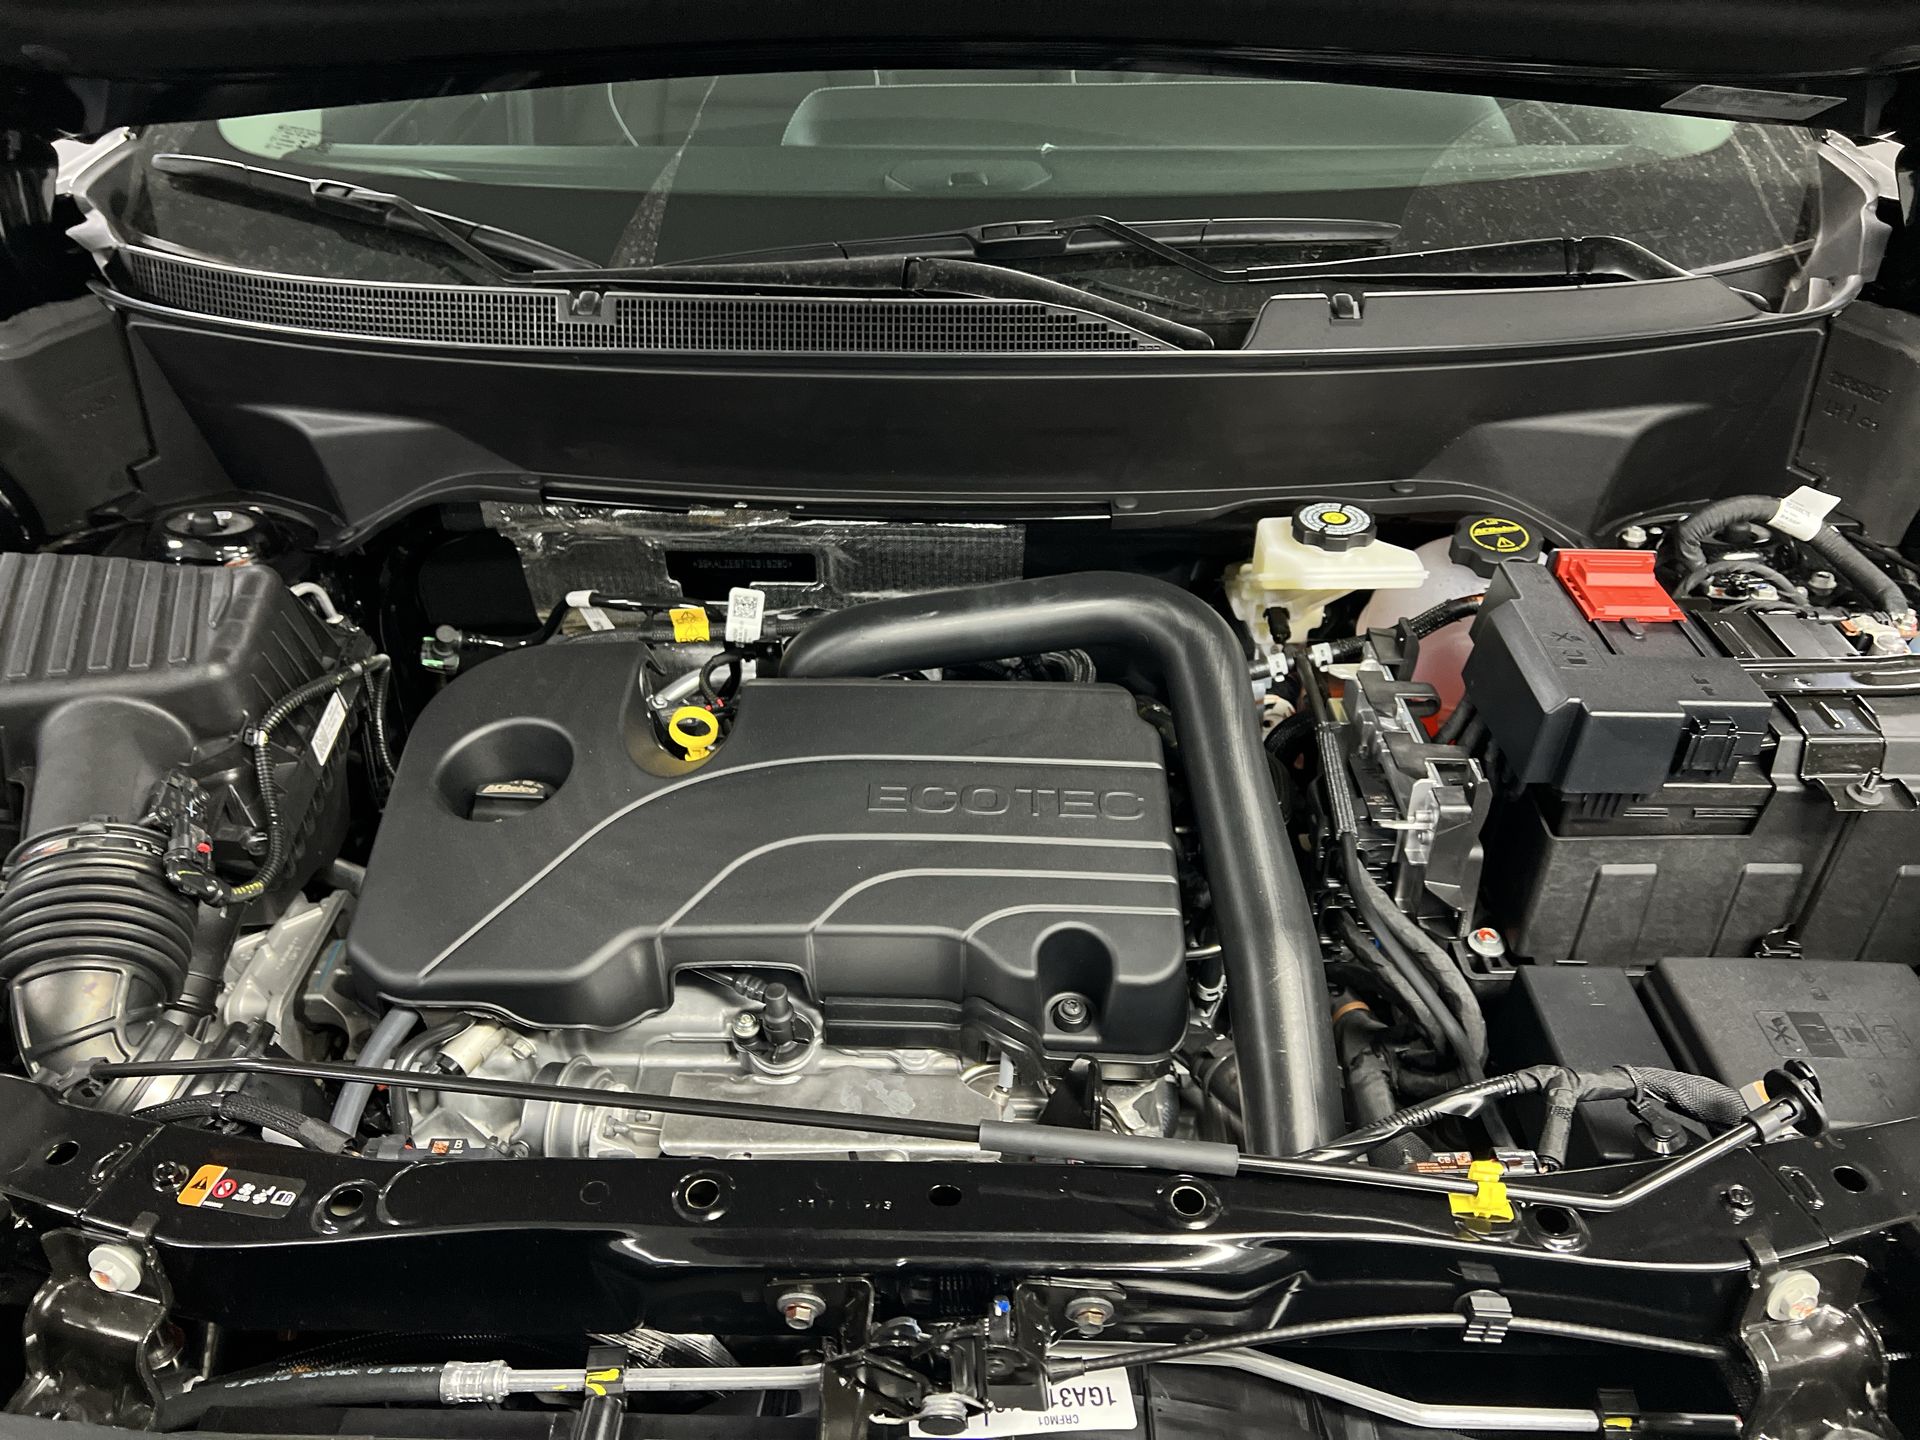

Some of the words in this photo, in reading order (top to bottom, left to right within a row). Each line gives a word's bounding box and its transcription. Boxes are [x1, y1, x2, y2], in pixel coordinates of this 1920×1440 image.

[867, 783, 1145, 821] ECOTEC
[454, 1140, 463, 1149] B
[1037, 1414, 1080, 1426] CRFM01
